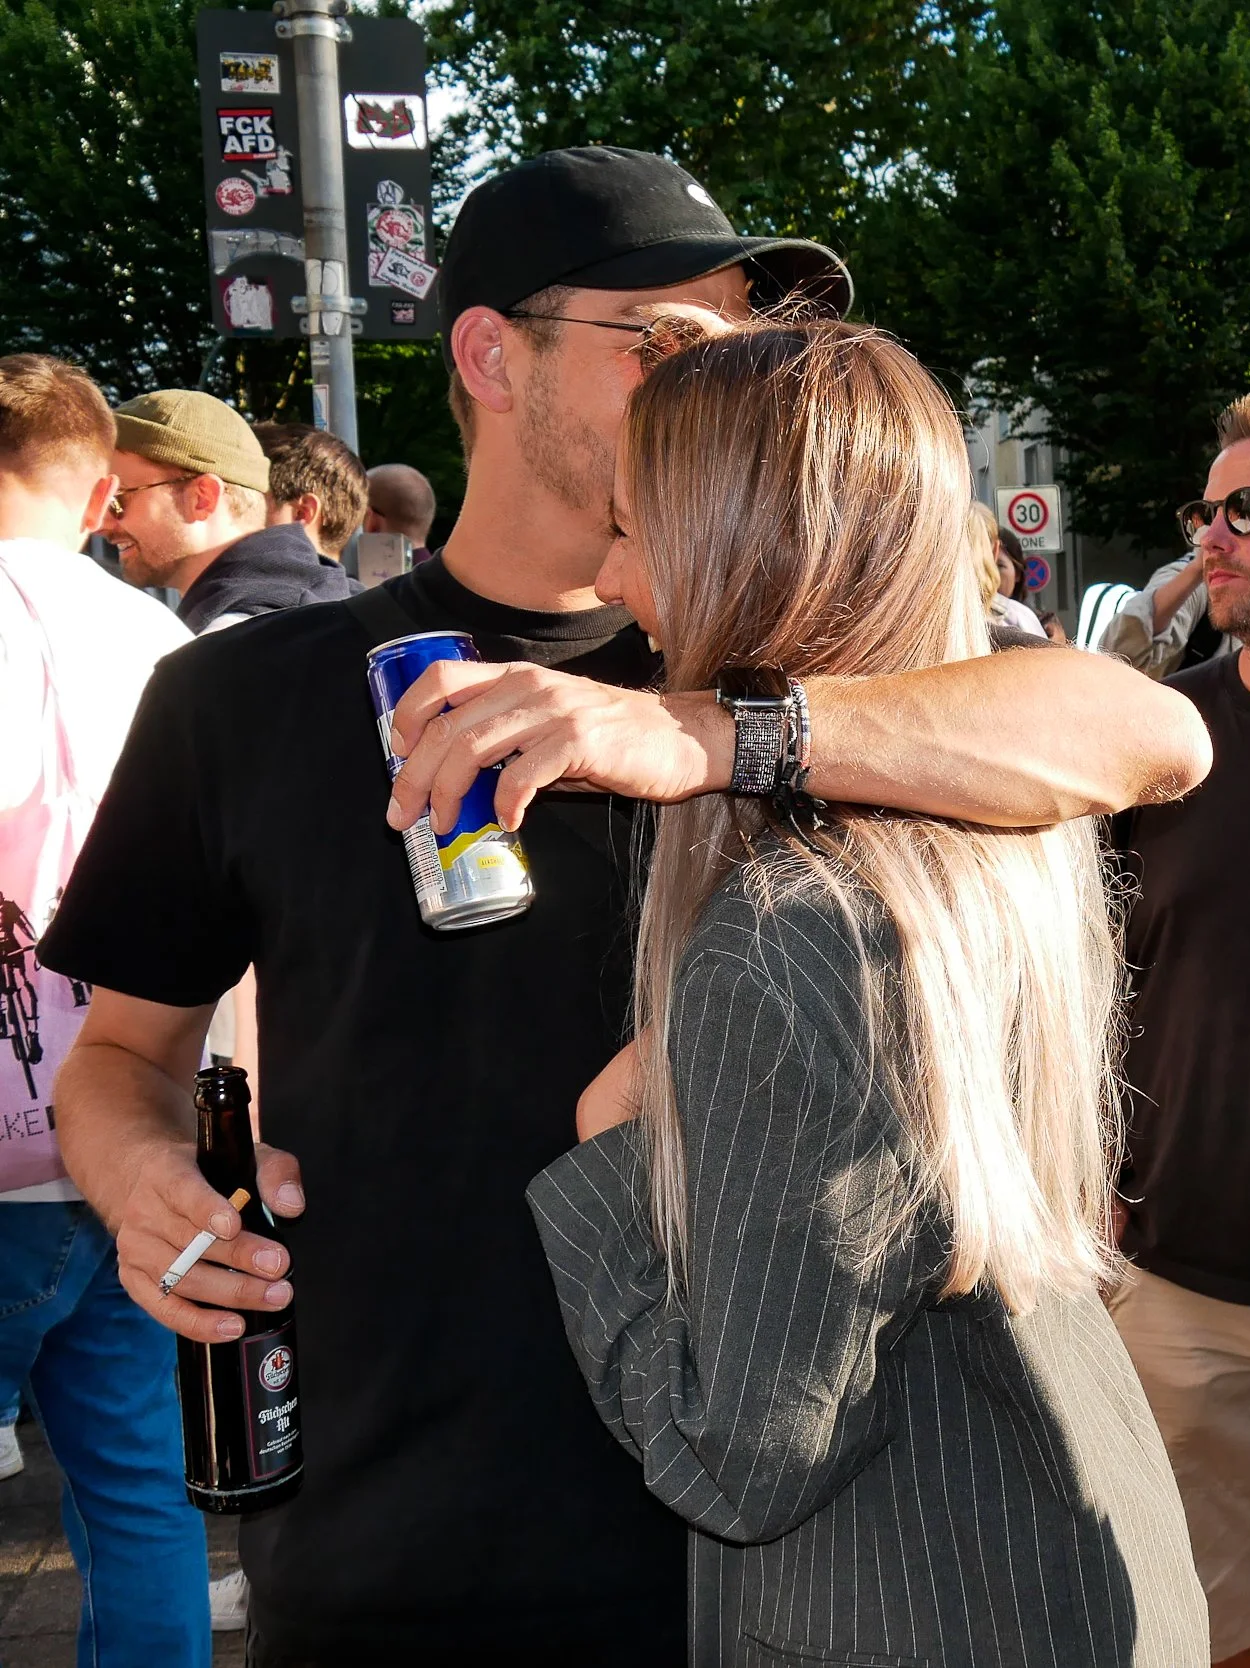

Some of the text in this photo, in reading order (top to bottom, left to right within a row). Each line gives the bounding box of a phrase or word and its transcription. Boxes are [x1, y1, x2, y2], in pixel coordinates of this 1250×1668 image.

[220, 116, 273, 134] FCK
[223, 135, 276, 153] AFD
[1016, 504, 1040, 523] 30
[1021, 537, 1045, 548] ONE
[0, 1109, 44, 1141] KE
[276, 1416, 290, 1432] Alt
